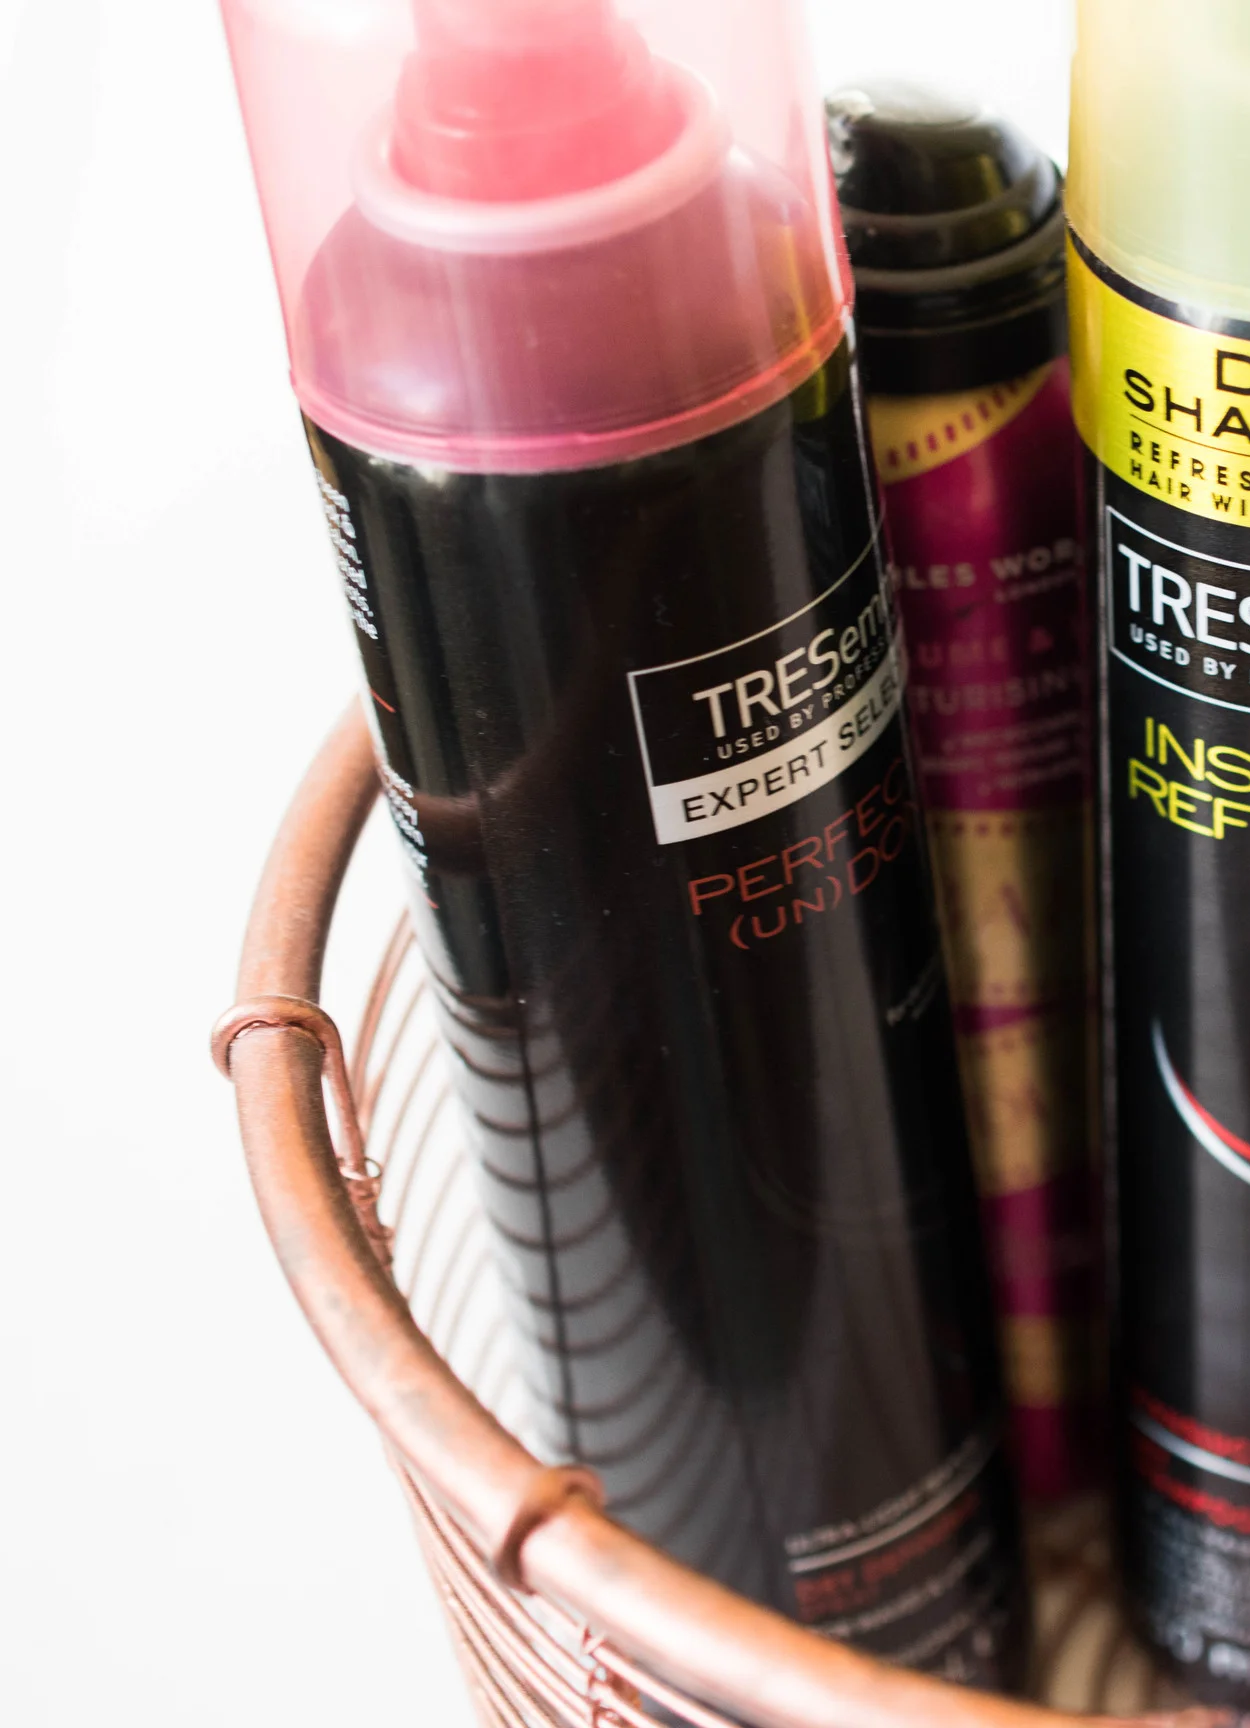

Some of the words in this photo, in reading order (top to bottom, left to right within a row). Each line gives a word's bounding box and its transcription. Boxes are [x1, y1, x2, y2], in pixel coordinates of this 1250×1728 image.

[1130, 459, 1193, 502] HAIR
[1129, 624, 1192, 666] USED
[1203, 659, 1238, 681] BY
[716, 725, 780, 760] USED
[789, 704, 815, 729] BY
[682, 740, 829, 823] EXPERT
